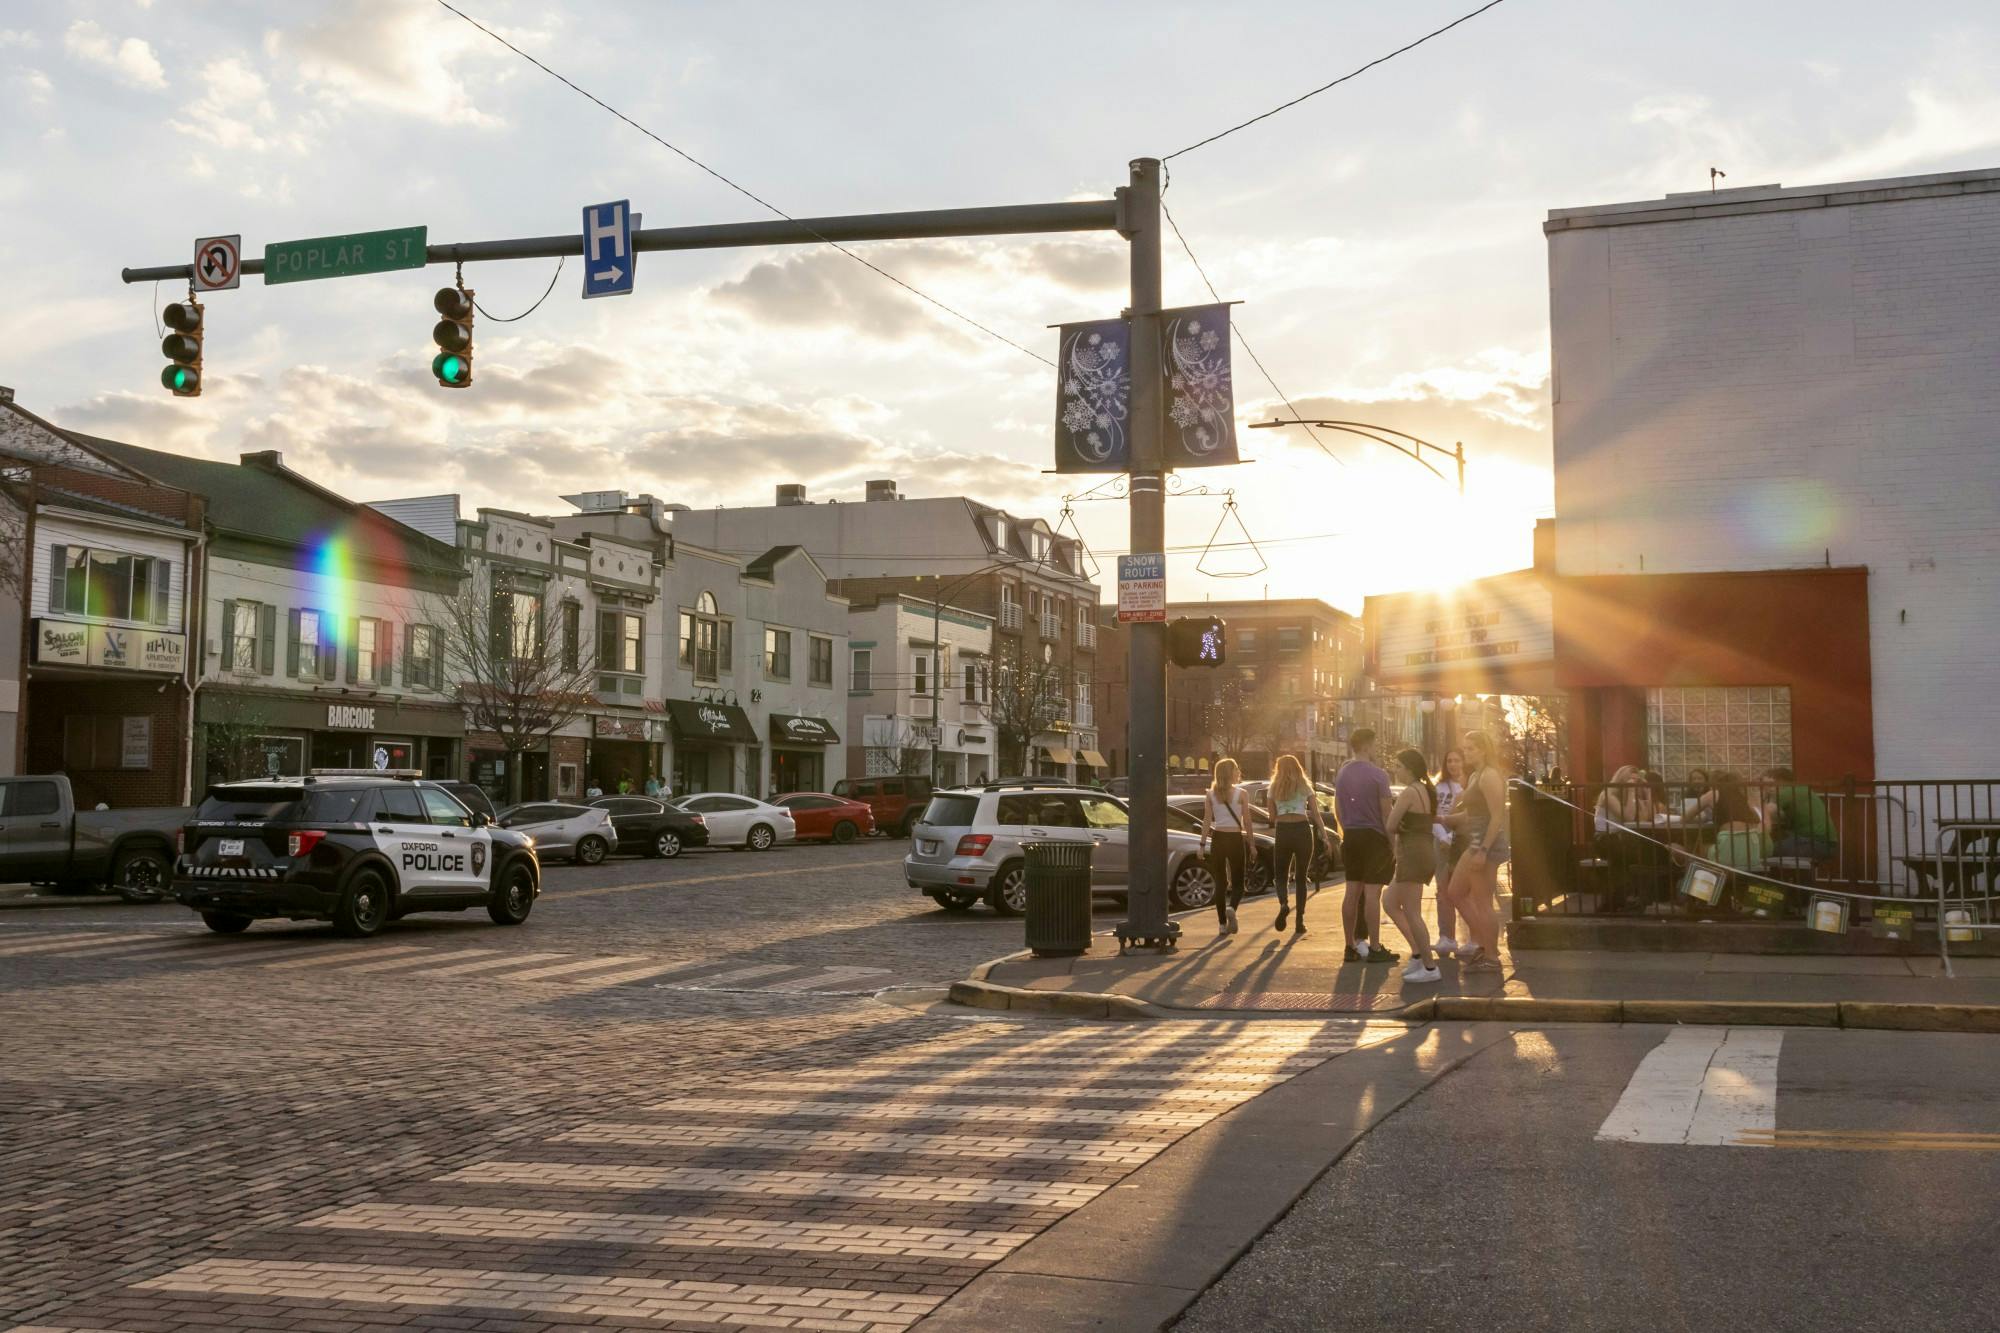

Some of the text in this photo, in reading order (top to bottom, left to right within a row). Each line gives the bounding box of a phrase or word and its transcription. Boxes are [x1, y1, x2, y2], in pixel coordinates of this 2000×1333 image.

[589, 205, 625, 261] H
[275, 238, 413, 273] POPLAR ST
[1127, 556, 1155, 567] SNOW
[1124, 567, 1159, 577] ROUTE
[1120, 581, 1164, 591] NO PARKING
[44, 629, 84, 646] SALON
[146, 637, 182, 655] HI-VUE
[327, 705, 375, 730] BARCODE
[401, 842, 438, 852] OXFORD
[402, 853, 464, 872] POLICE
